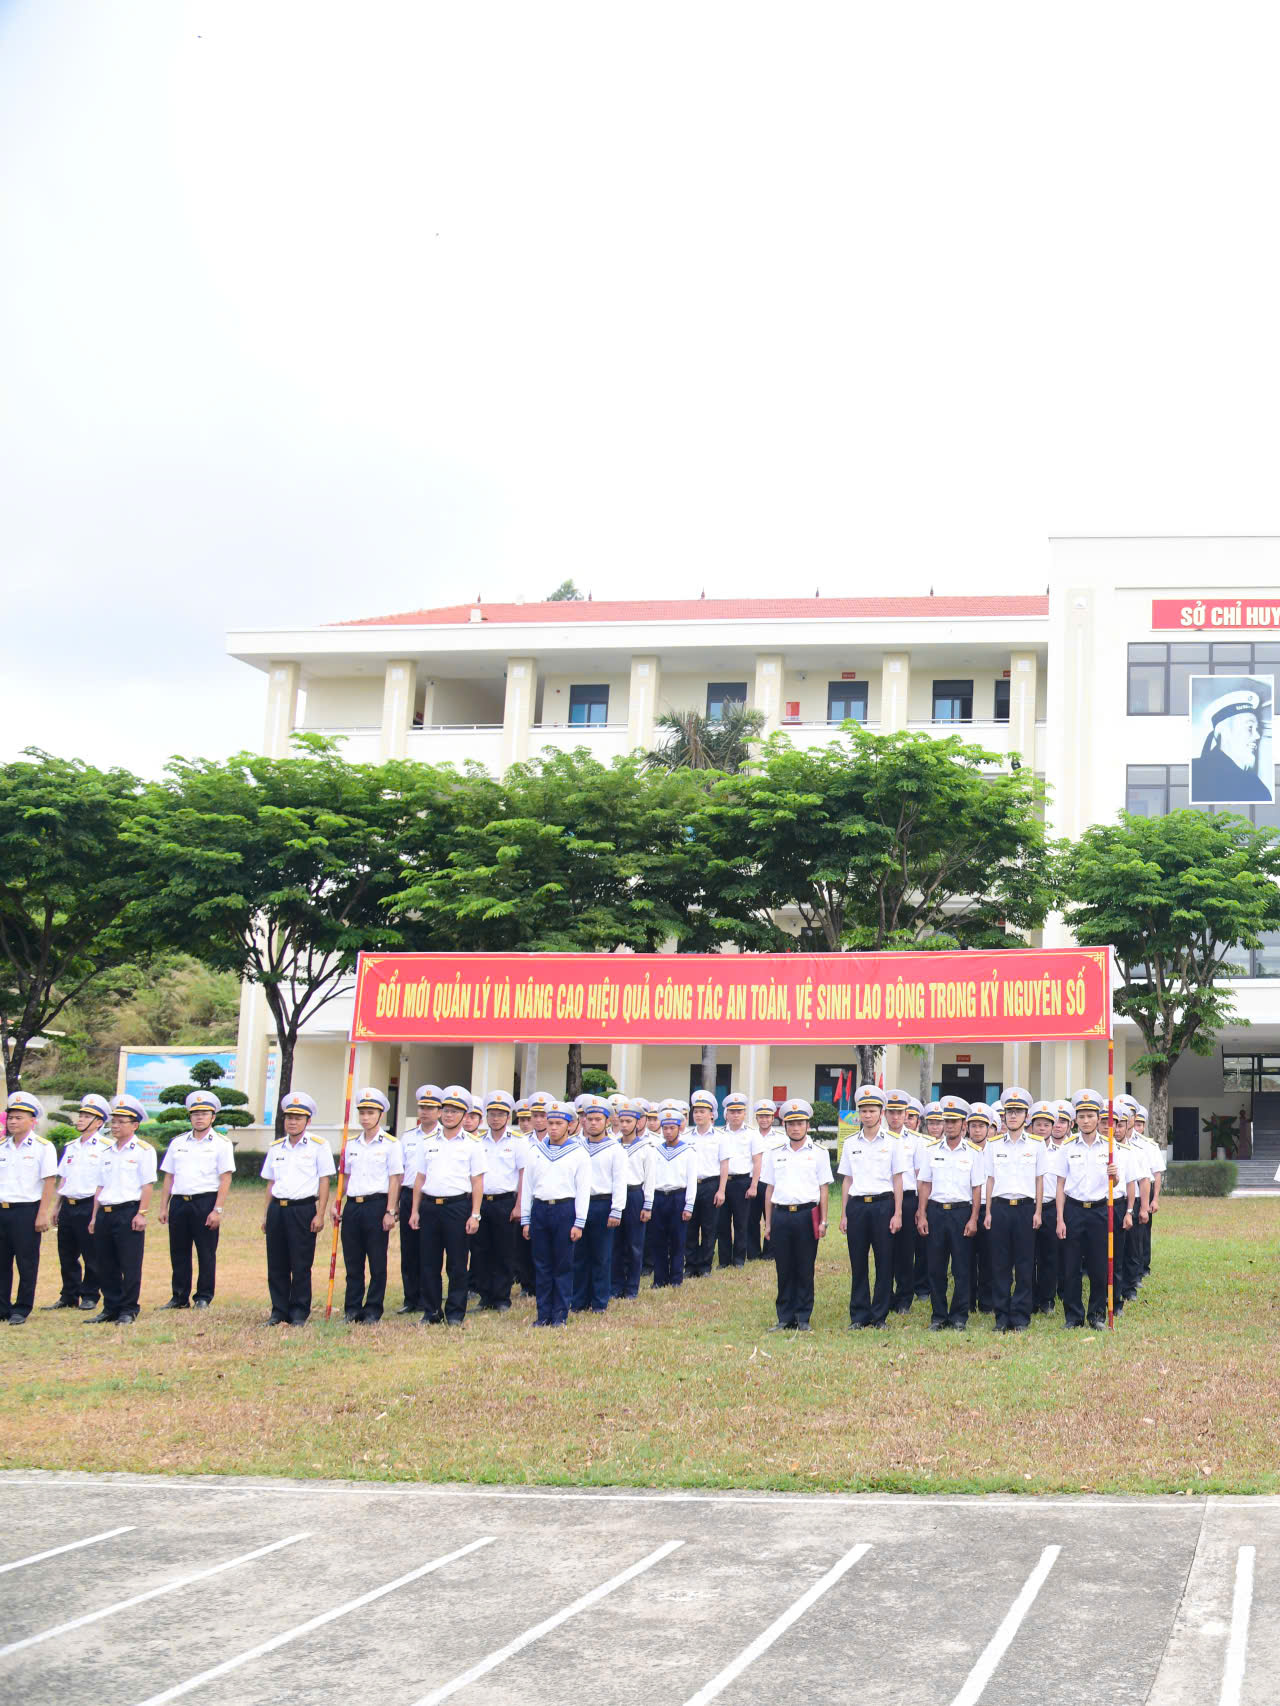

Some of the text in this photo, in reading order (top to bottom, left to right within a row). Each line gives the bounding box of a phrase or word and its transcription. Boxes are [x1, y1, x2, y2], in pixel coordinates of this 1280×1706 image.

[1180, 600, 1206, 626] SỞ
[1210, 600, 1242, 626] CHỈ
[375, 965, 1086, 1029] ĐỔI MỚI QUẢN LÝ VÀ NÂNG CAO HIỆU QUẢ CÔNG TÁC AN TOÀN, VỆ SINH LAO ĐỘNG TRONG KỶ NGUYÊN SỐ
